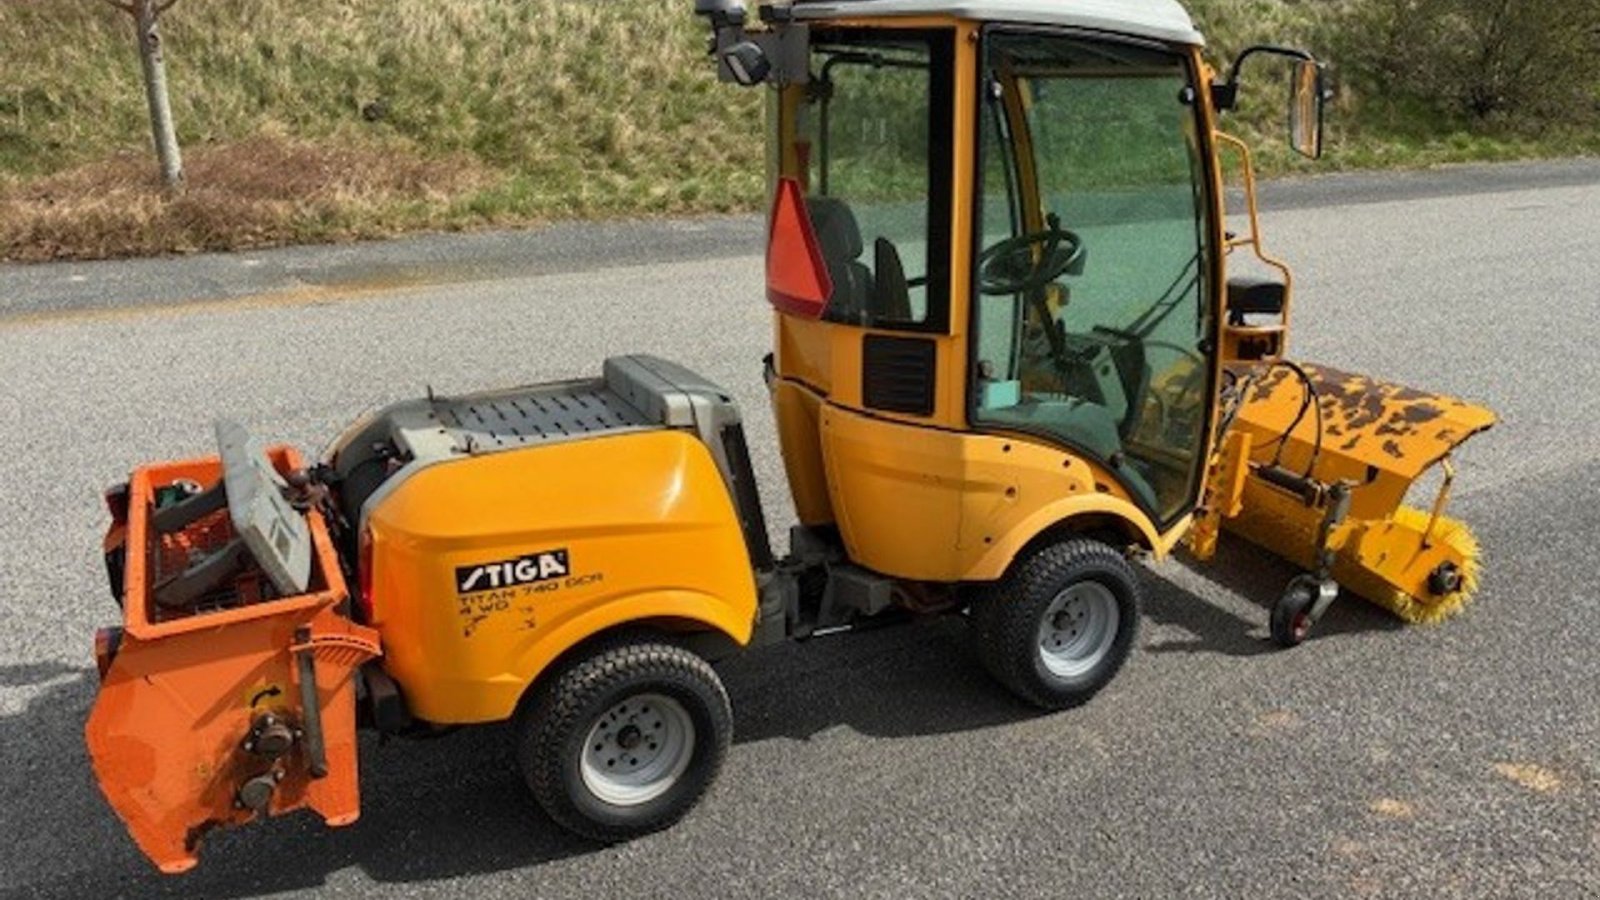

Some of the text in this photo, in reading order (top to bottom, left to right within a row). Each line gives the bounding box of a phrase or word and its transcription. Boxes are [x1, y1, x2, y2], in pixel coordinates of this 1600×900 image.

[461, 552, 566, 591] STIGA
[460, 589, 516, 605] TITAN
[522, 581, 559, 594] 740
